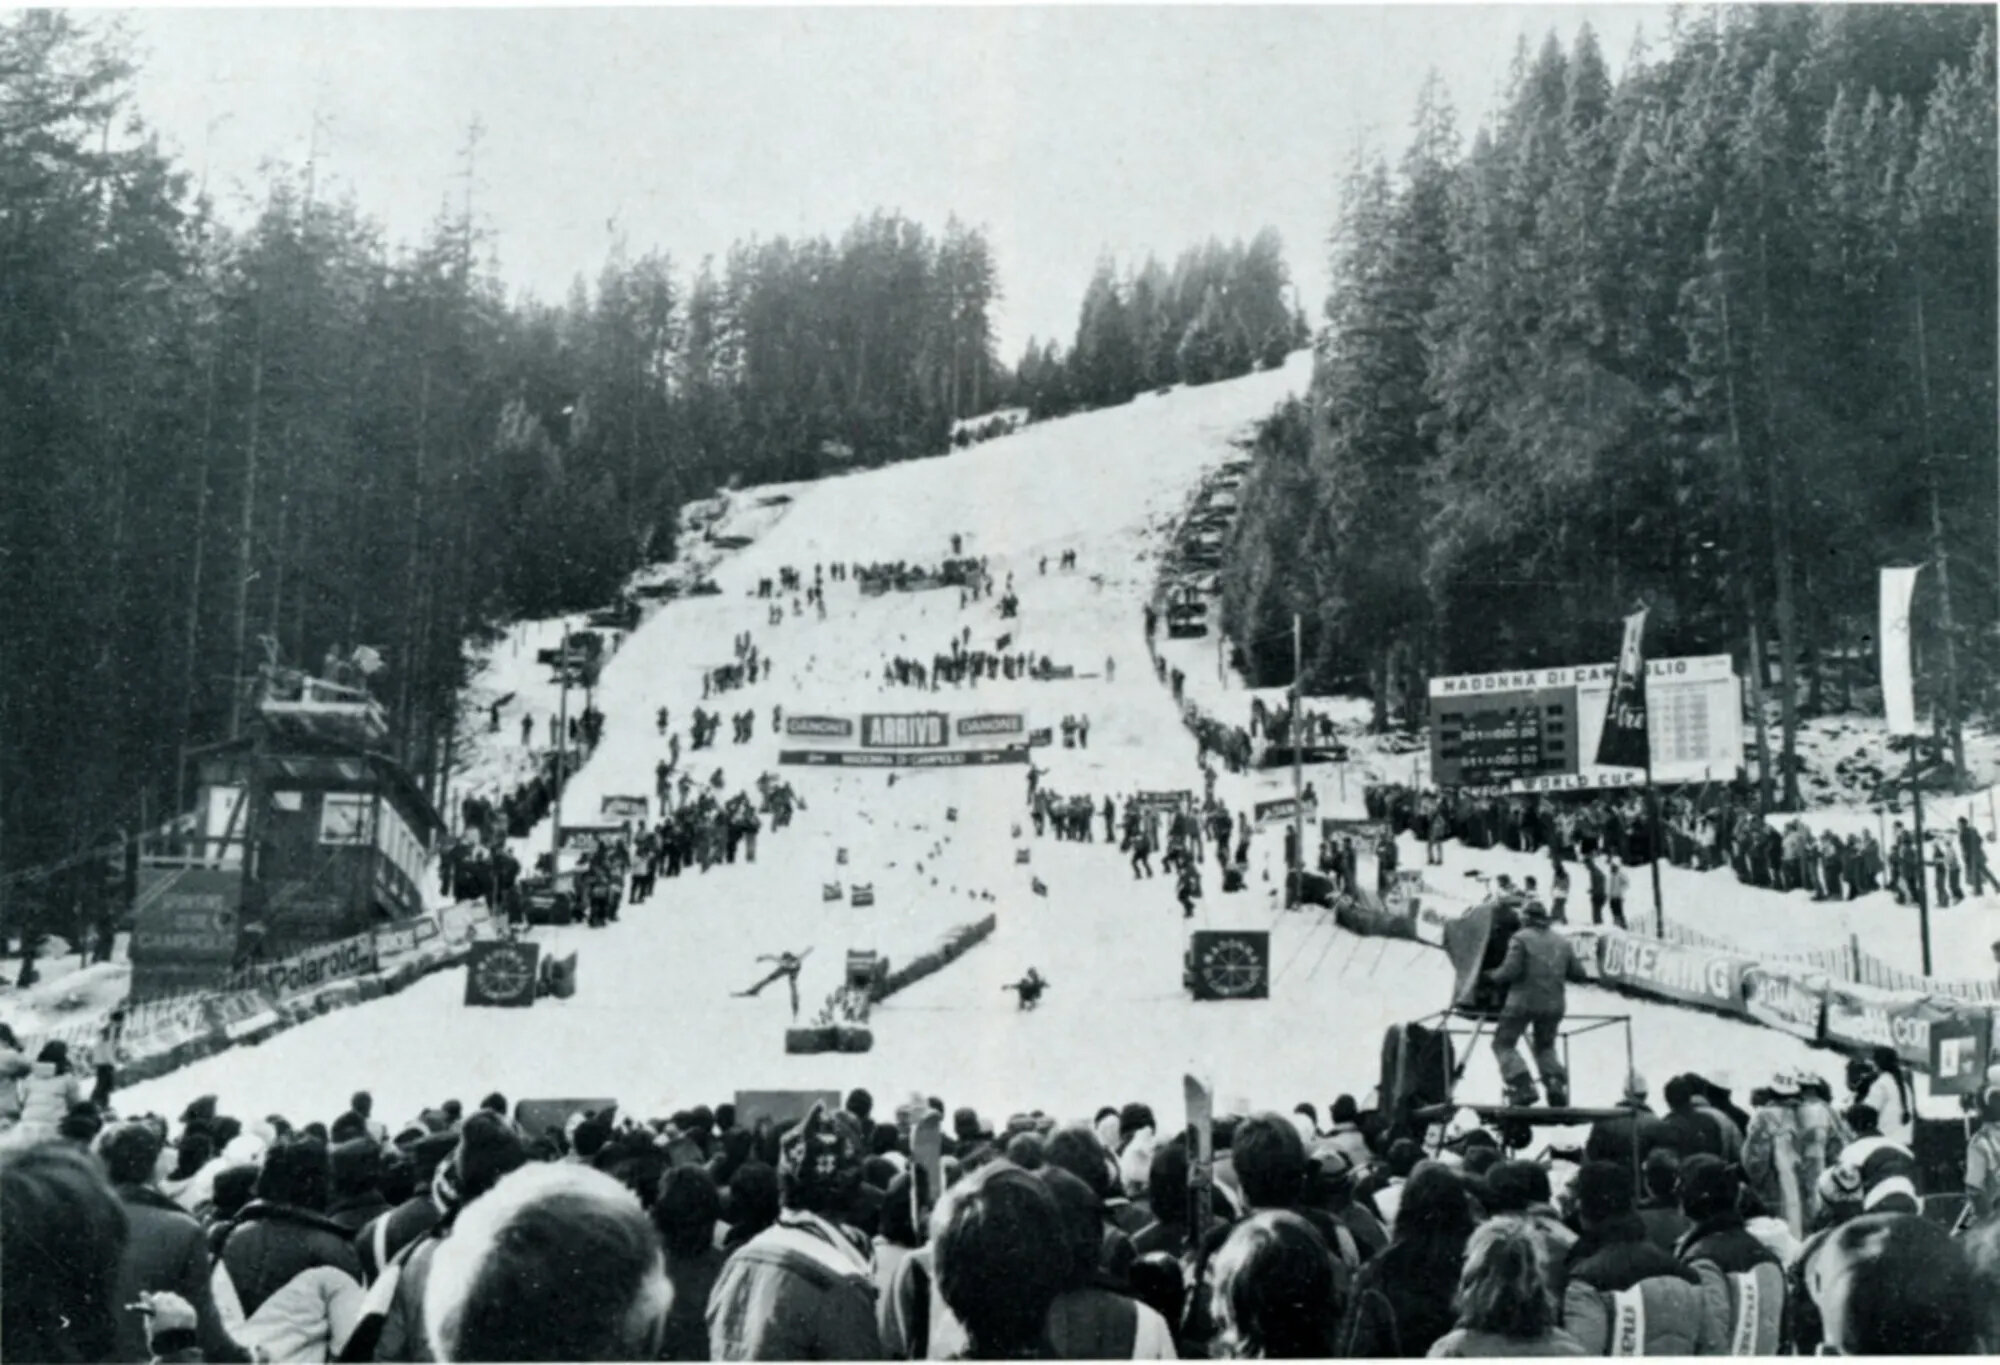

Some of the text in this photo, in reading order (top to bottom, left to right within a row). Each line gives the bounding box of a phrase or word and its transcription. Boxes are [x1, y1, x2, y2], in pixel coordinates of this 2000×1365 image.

[1443, 660, 1687, 692] MADONNA DI CAMGLIO
[789, 719, 847, 735] DANONE
[869, 715, 942, 746] ARRIVO
[960, 716, 1019, 734] DANONE
[1522, 771, 1636, 791] WORLD CUP
[270, 942, 360, 995] Polaroid
